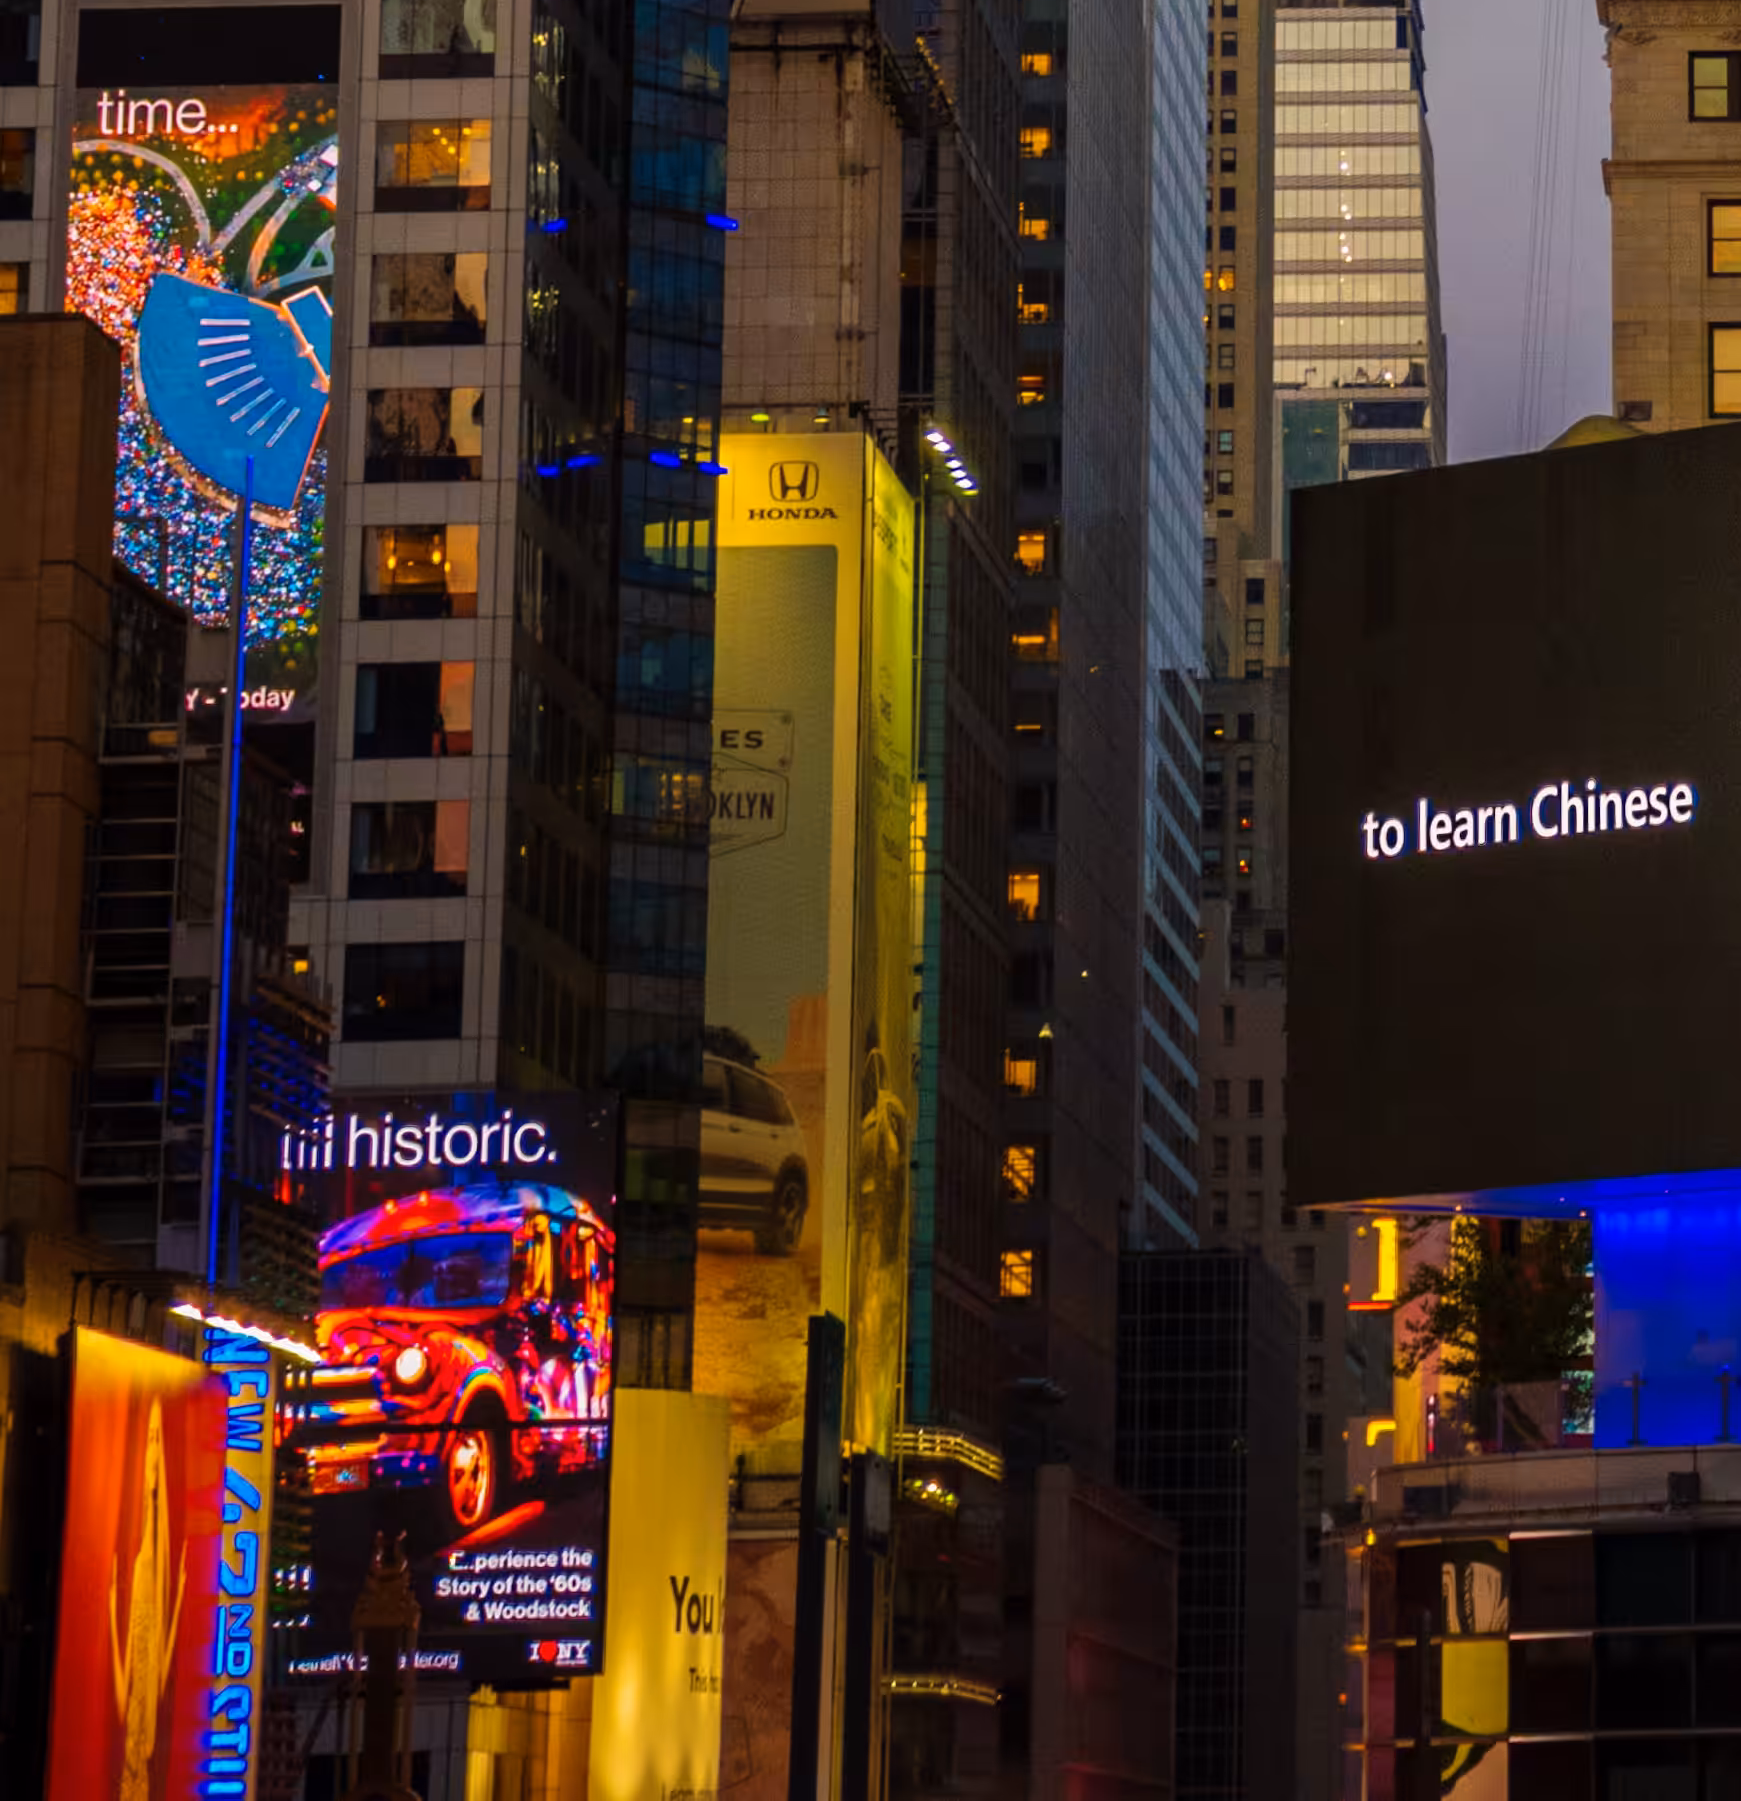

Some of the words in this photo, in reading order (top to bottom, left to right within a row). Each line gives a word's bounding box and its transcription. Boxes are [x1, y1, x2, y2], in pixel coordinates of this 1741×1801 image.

[97, 89, 240, 135] time...
[748, 507, 839, 521] HONDA
[1363, 805, 1406, 858] to
[1417, 796, 1520, 852] learn
[1531, 777, 1695, 838] Chinese
[347, 1108, 558, 1168] historic.
[449, 1549, 558, 1574] Eperience
[562, 1546, 593, 1567] the
[437, 1577, 491, 1599] Story
[493, 1574, 515, 1594] of
[516, 1574, 548, 1593] the
[669, 1575, 714, 1634] You
[465, 1601, 482, 1621] &
[484, 1599, 591, 1620] Woodstock
